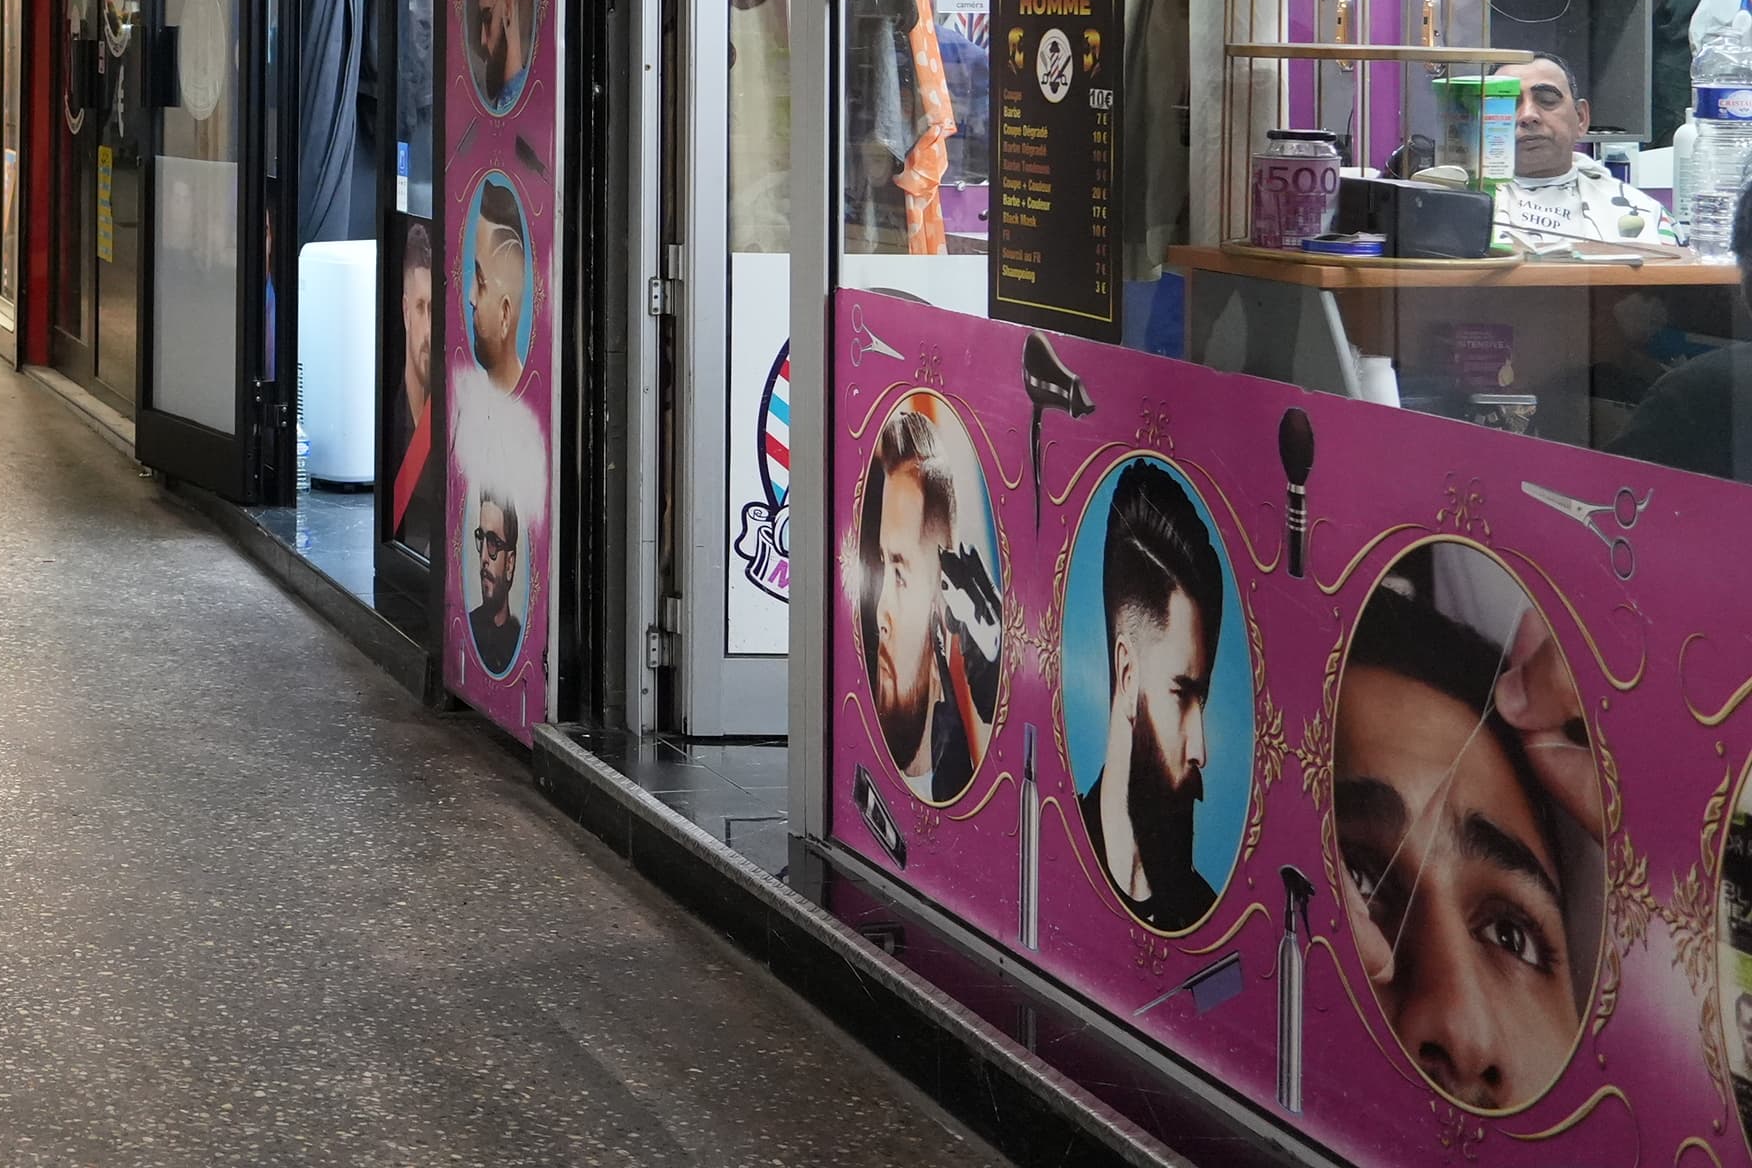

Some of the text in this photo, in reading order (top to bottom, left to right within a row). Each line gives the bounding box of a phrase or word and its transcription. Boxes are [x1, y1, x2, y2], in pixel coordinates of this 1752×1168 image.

[1003, 106, 1021, 118] Barbe
[1003, 124, 1022, 138] Coupe
[1003, 176, 1021, 191] Coupe
[1003, 194, 1021, 208] Barbe
[1003, 211, 1019, 225] Black
[1020, 214, 1037, 228] Mask
[1521, 212, 1561, 230] SHOP
